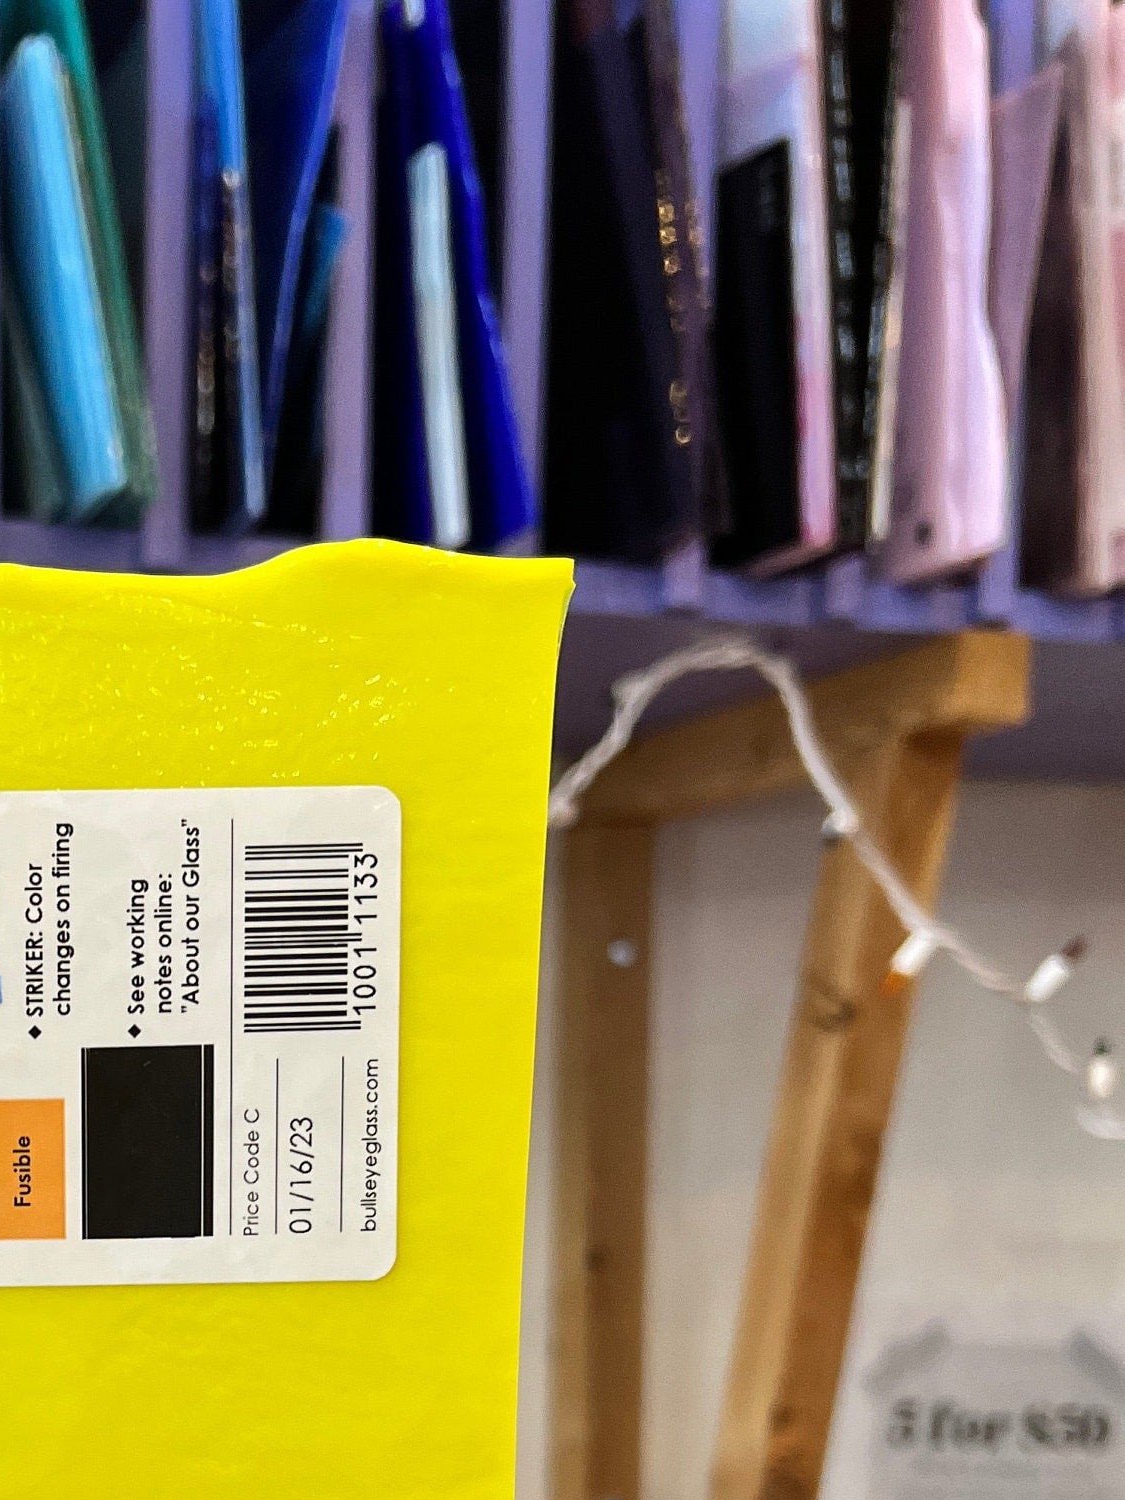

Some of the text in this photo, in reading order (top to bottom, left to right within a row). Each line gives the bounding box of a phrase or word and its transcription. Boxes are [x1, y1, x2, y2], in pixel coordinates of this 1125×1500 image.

[24, 862, 44, 1017] STRIKER: Color
[51, 822, 75, 1016] changes on firing
[126, 878, 149, 1014] See working
[153, 872, 173, 1014] notes online:
[180, 818, 200, 1014] "About our Glass"
[13, 1135, 32, 1208] Fusible
[241, 1107, 260, 1236] Price Code C
[288, 1116, 315, 1234] 01/16/23
[359, 1057, 382, 1233] bullseyeglass.com
